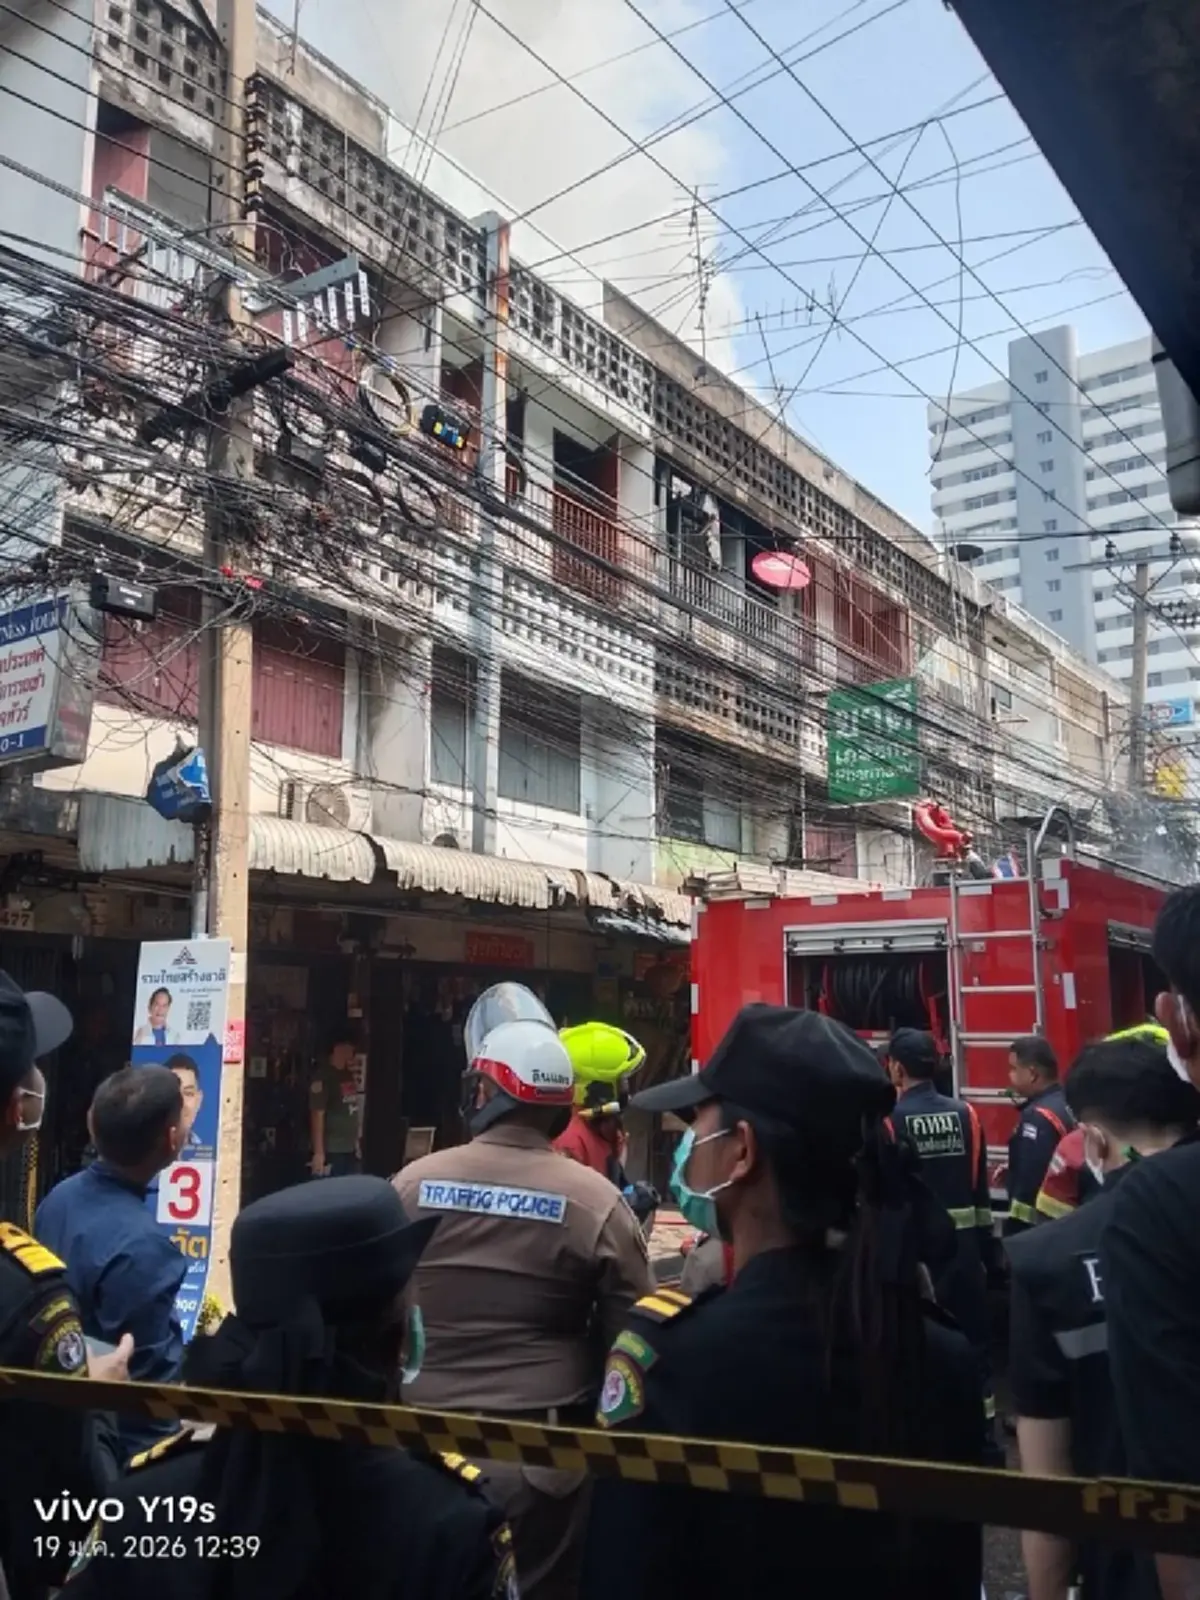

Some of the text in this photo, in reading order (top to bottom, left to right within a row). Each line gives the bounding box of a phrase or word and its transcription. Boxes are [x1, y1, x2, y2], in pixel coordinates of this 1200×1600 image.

[141, 967, 227, 984] รวมไทยสร้างชาติ
[168, 1166, 202, 1220] 3
[424, 1184, 563, 1218] TRAFFIC POLICE
